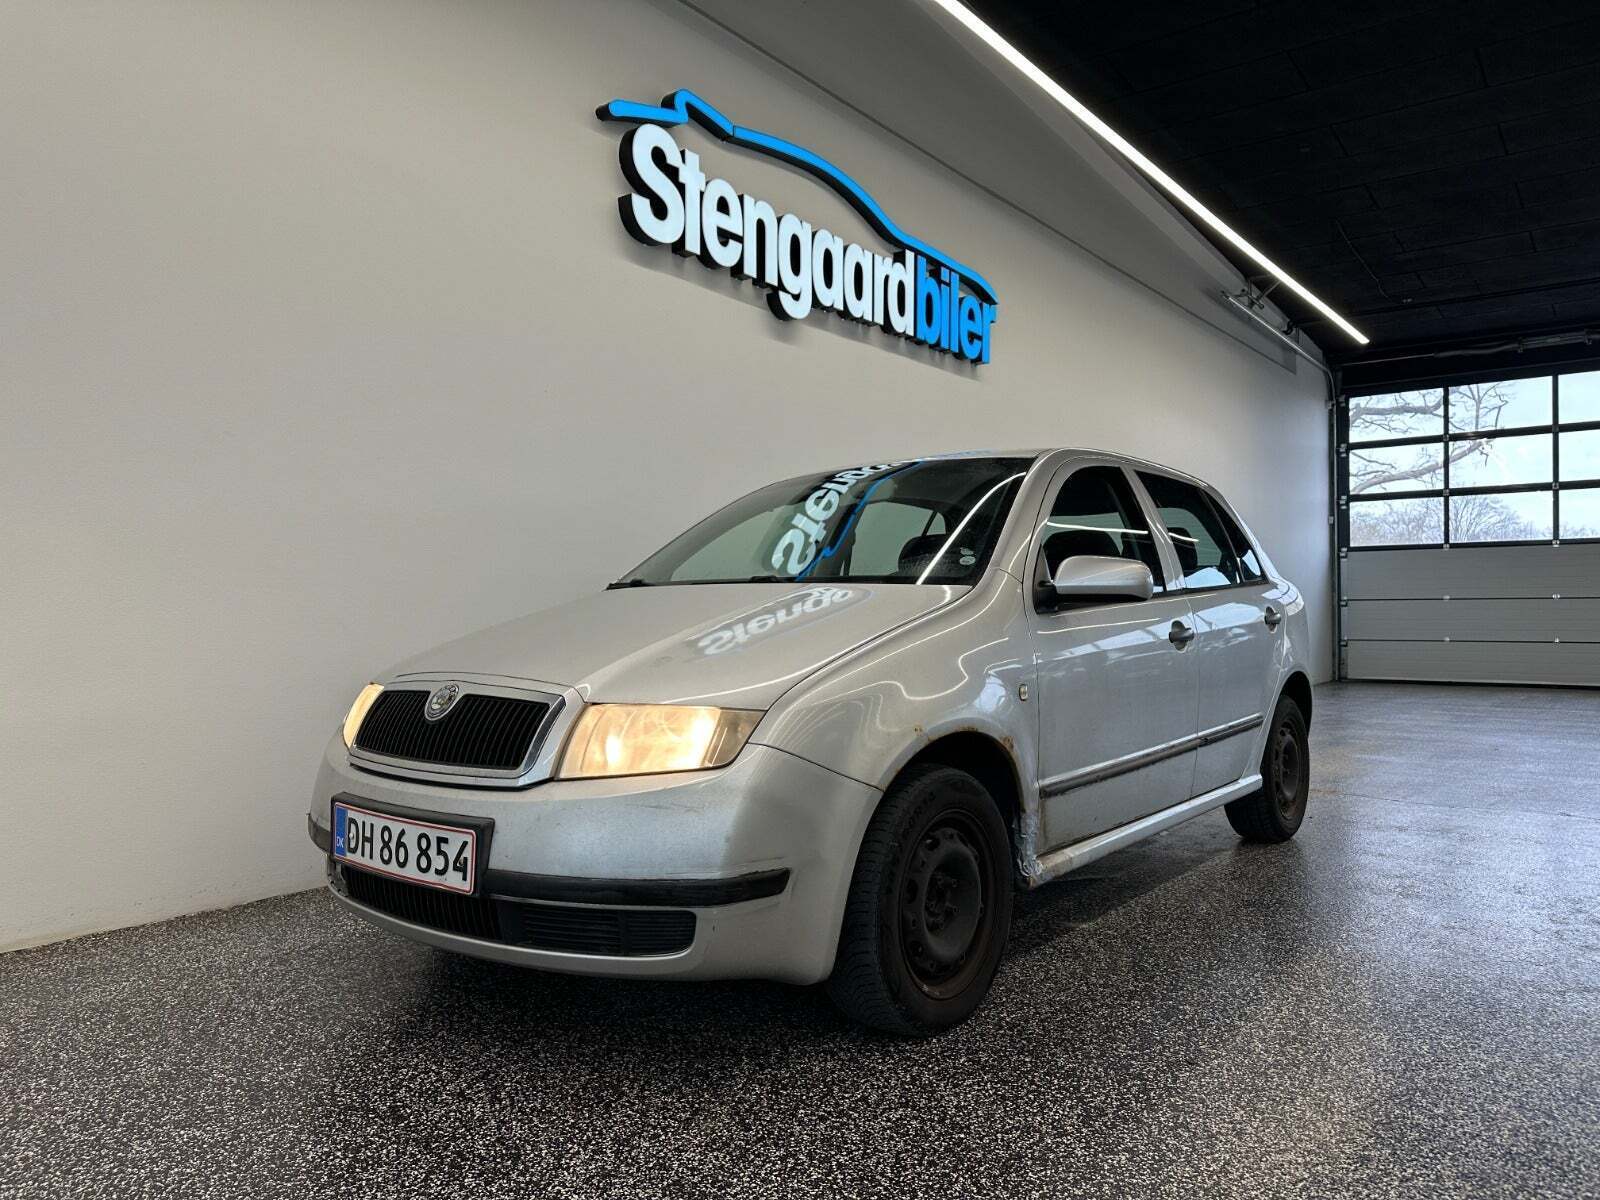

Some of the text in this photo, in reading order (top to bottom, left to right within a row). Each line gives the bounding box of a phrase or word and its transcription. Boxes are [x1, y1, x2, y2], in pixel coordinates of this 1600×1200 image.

[347, 817, 469, 882] DH 86 854
